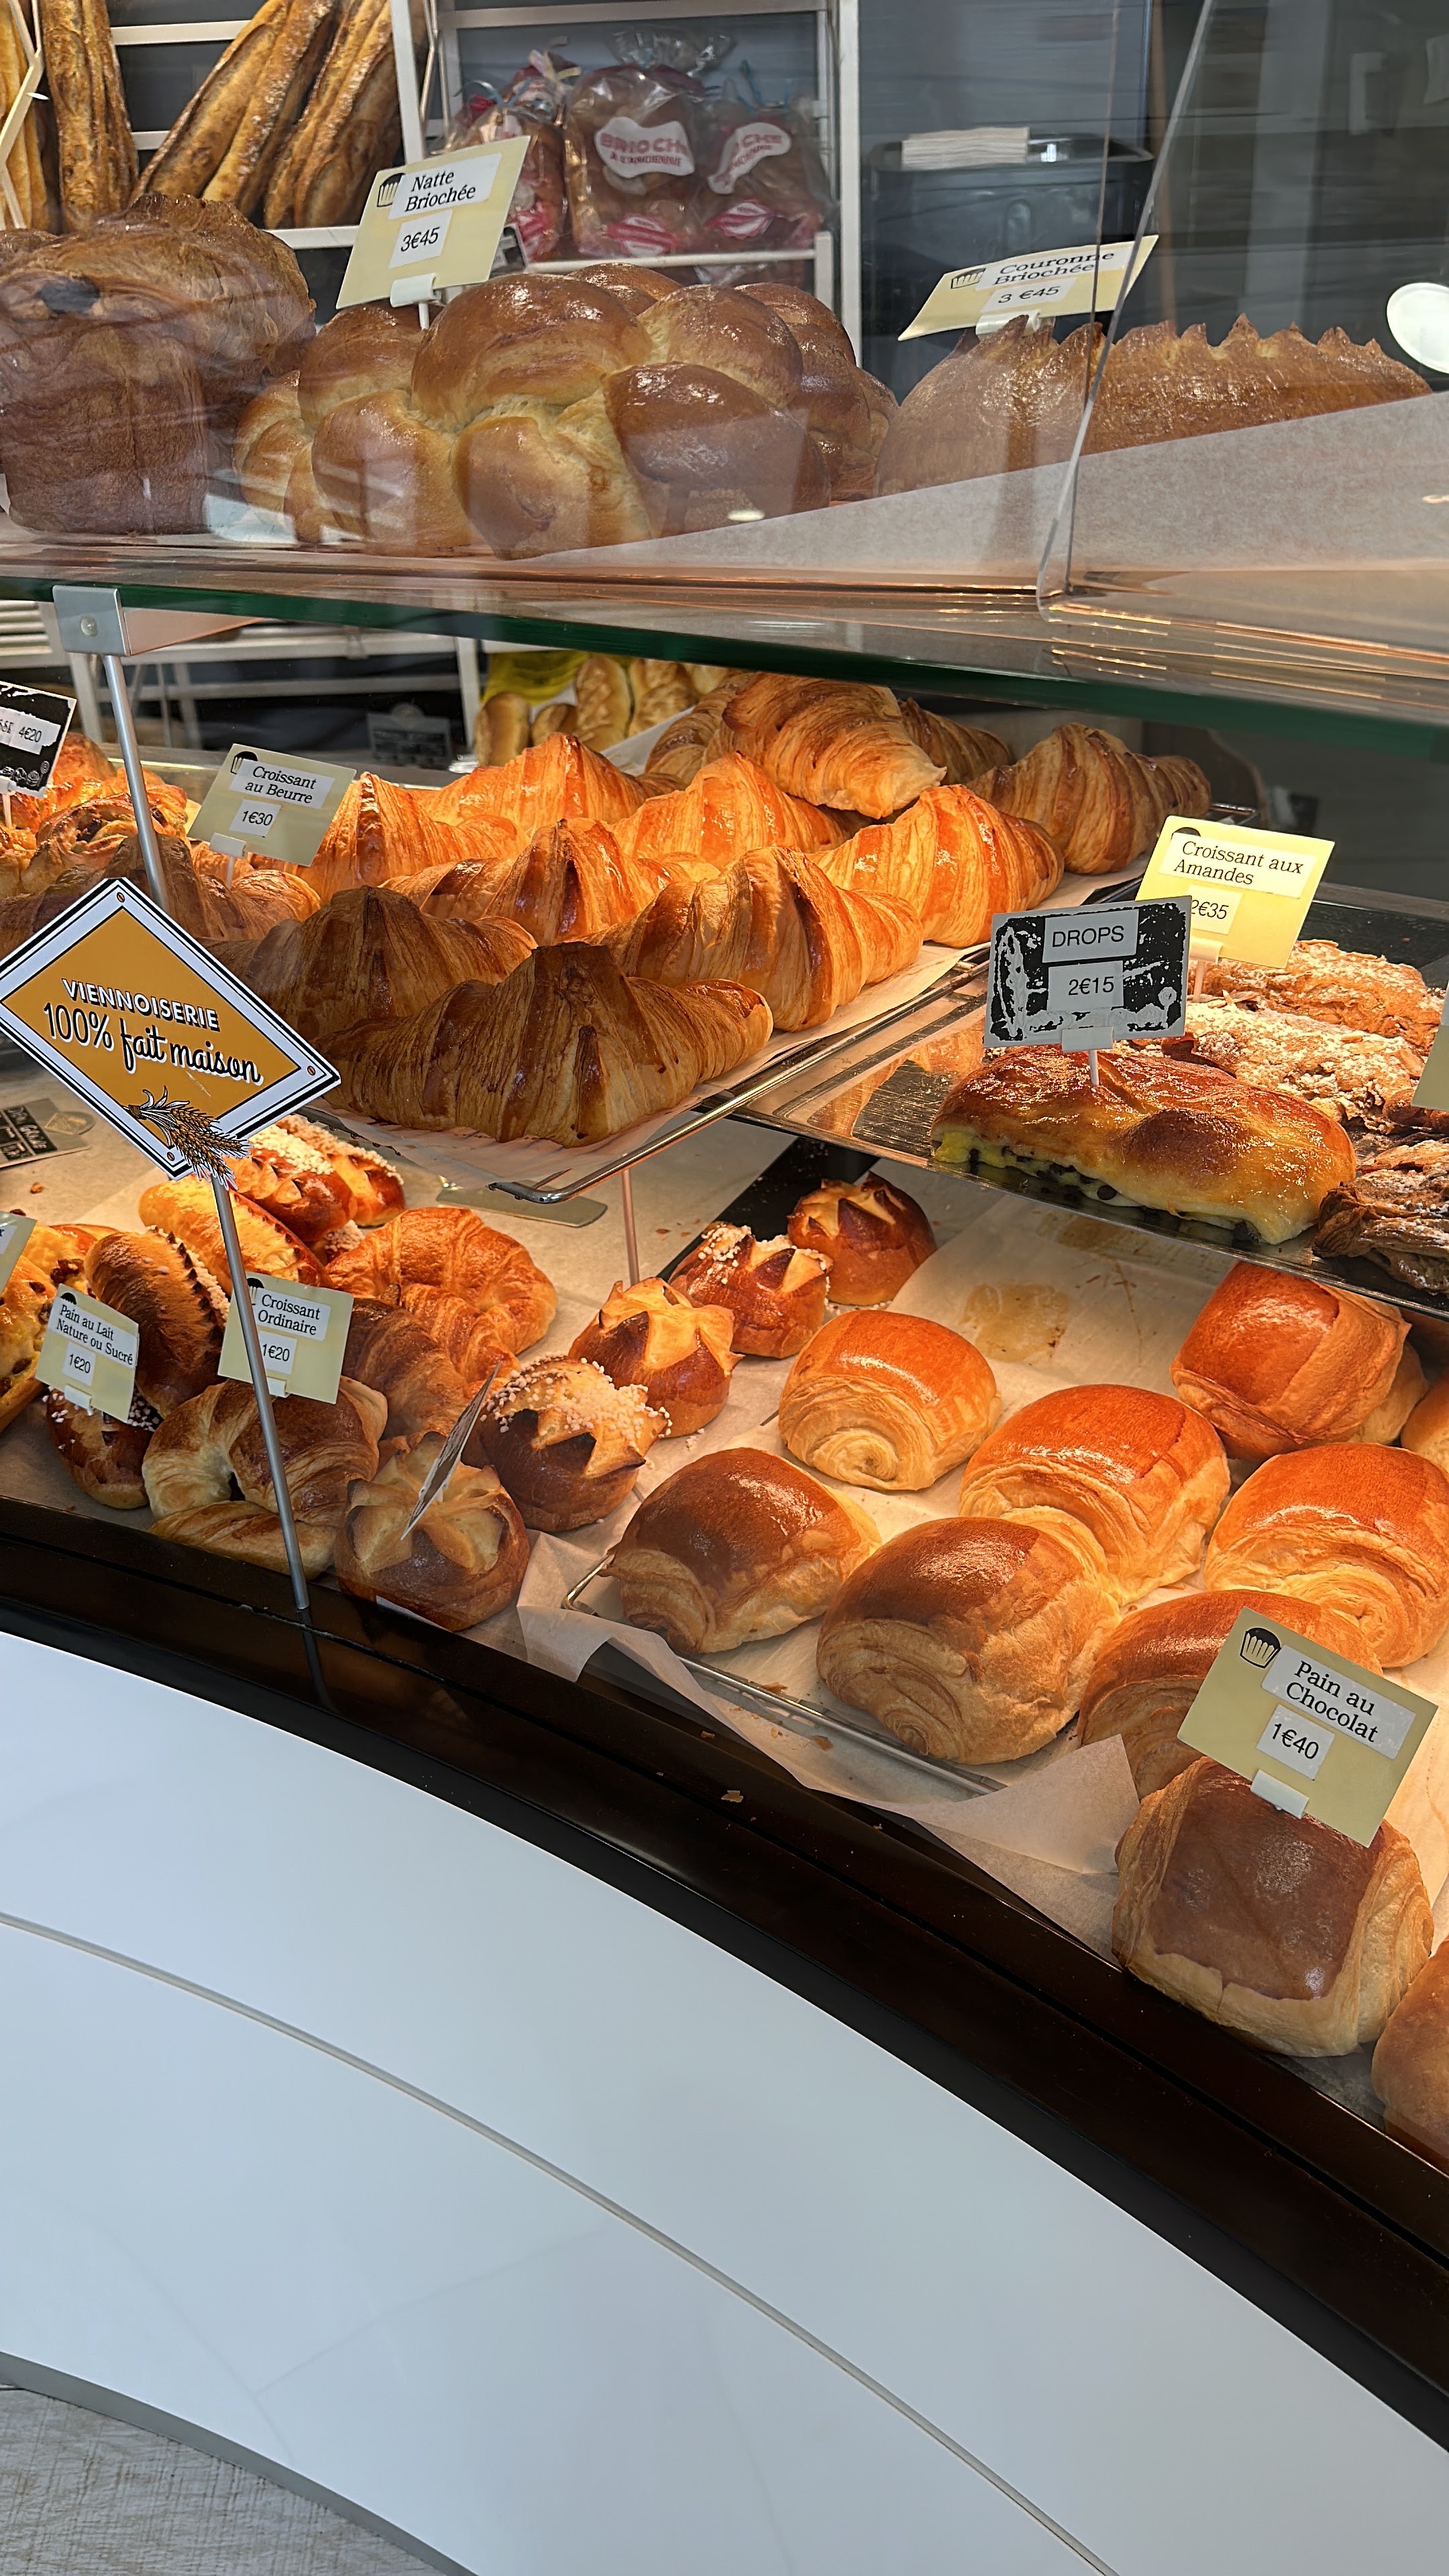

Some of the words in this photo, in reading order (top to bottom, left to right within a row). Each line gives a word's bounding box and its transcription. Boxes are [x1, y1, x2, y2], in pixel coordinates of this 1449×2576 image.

[411, 170, 455, 193] Natte
[404, 184, 476, 212] Briochée
[400, 226, 440, 252] 3€45
[993, 264, 1095, 285] Briochée
[1000, 252, 1115, 275] Couronne
[18, 725, 42, 743] 4€20
[252, 765, 317, 790] Croissant
[245, 782, 264, 793] au
[266, 784, 313, 804] Beurre
[241, 810, 273, 826] 1€30
[1182, 840, 1265, 868] Croissant
[1268, 858, 1305, 874] aux
[1173, 859, 1254, 885] Amandes
[1191, 899, 1230, 920] 2€35
[1051, 925, 1125, 948] DROPS
[1067, 976, 1114, 996] 2€15
[61, 977, 221, 1032] VIENNOISERIE
[44, 1002, 115, 1051] 100%
[119, 1017, 167, 1075] fait
[169, 1040, 264, 1086] maison
[262, 1294, 321, 1320] Croissant
[60, 1304, 80, 1324] Pain
[82, 1318, 94, 1330] au
[96, 1322, 114, 1341] Lait
[258, 1309, 317, 1336] Ordinaire
[56, 1318, 89, 1343] Nature
[91, 1338, 103, 1350] ou
[105, 1342, 133, 1365] Sucré
[262, 1344, 290, 1362] 1€20
[70, 1353, 91, 1374] 1€20
[1294, 1660, 1341, 1698] Pain
[1346, 1692, 1375, 1716] au
[1286, 1682, 1379, 1743] Chocolat
[1272, 1723, 1320, 1760] 1€40
